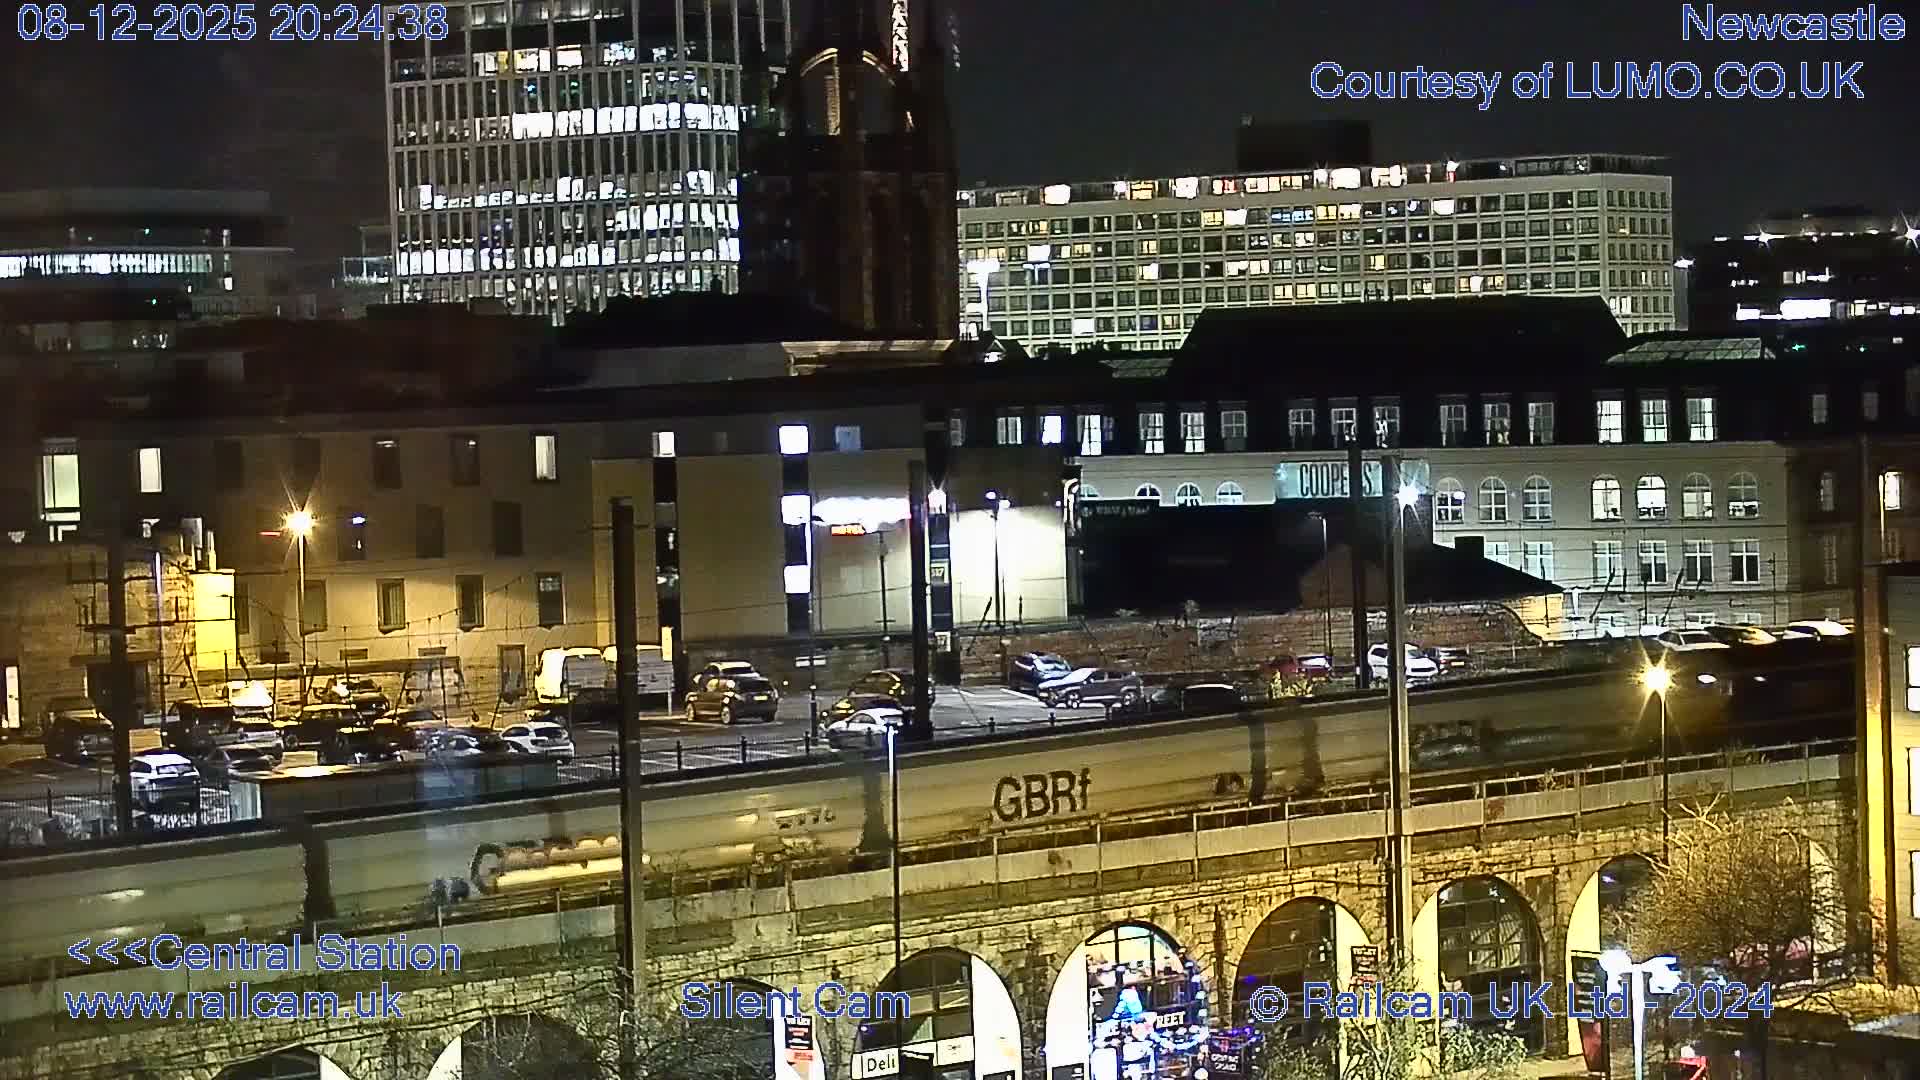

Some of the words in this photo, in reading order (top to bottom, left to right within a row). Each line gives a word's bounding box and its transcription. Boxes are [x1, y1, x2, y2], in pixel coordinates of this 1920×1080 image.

[1300, 462, 1373, 497] COOPES
[992, 768, 1092, 822] GBRf
[867, 1053, 896, 1073] Deli
